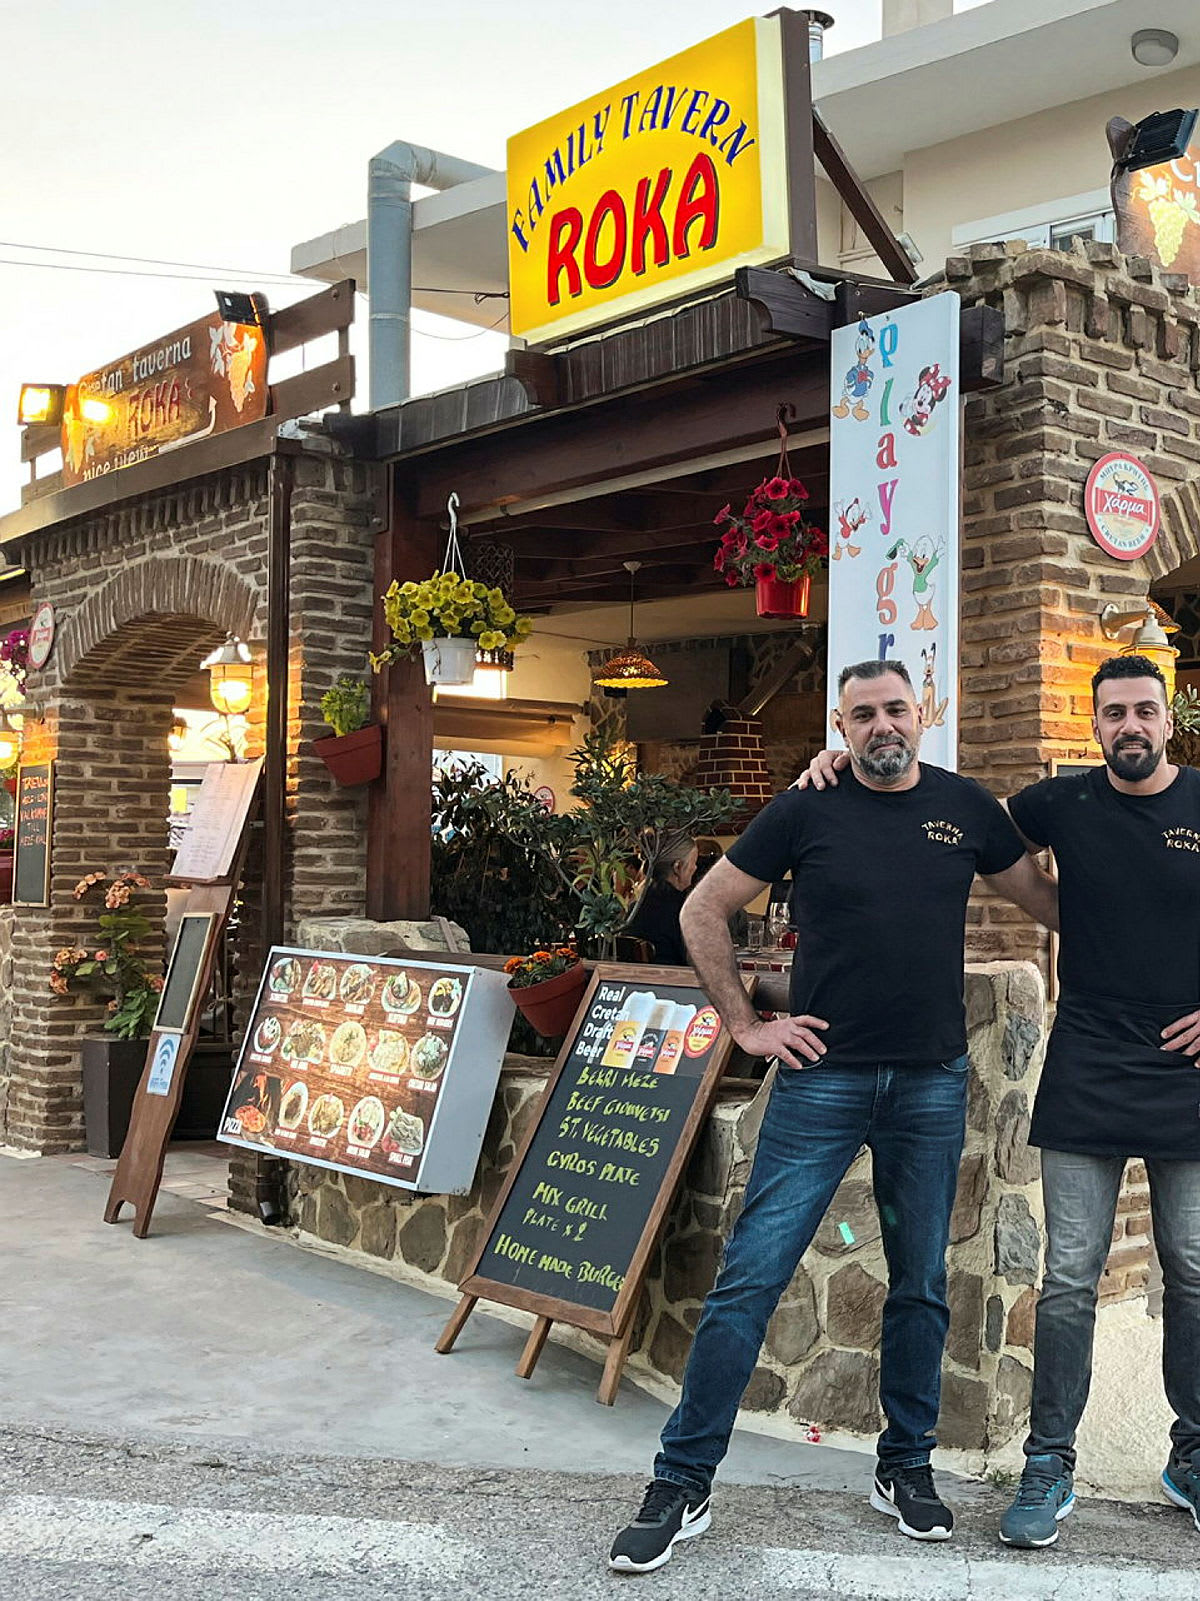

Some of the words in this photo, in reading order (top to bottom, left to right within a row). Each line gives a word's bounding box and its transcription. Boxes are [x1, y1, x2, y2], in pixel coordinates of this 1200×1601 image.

[511, 104, 611, 253] FAMILY
[620, 84, 755, 167] TAVERN
[548, 152, 720, 306] ROKA
[132, 336, 191, 383] taverna
[921, 820, 963, 840] TAVERNA
[928, 831, 958, 846] ROKA
[1167, 839, 1200, 853] ROKA
[599, 986, 626, 1001] Real
[583, 1022, 614, 1039] Draft
[575, 1041, 604, 1058] Beer
[566, 1091, 604, 1111] BEEF
[581, 1120, 660, 1157] VEGETABLES
[547, 1151, 597, 1176] GYROS
[599, 1162, 640, 1186] PLATE
[532, 1182, 563, 1206] MIX
[565, 1197, 608, 1221] GRILL
[522, 1208, 560, 1231] PLATE
[572, 1222, 587, 1242] 2
[494, 1234, 538, 1265] HOME
[537, 1254, 573, 1279] MADE
